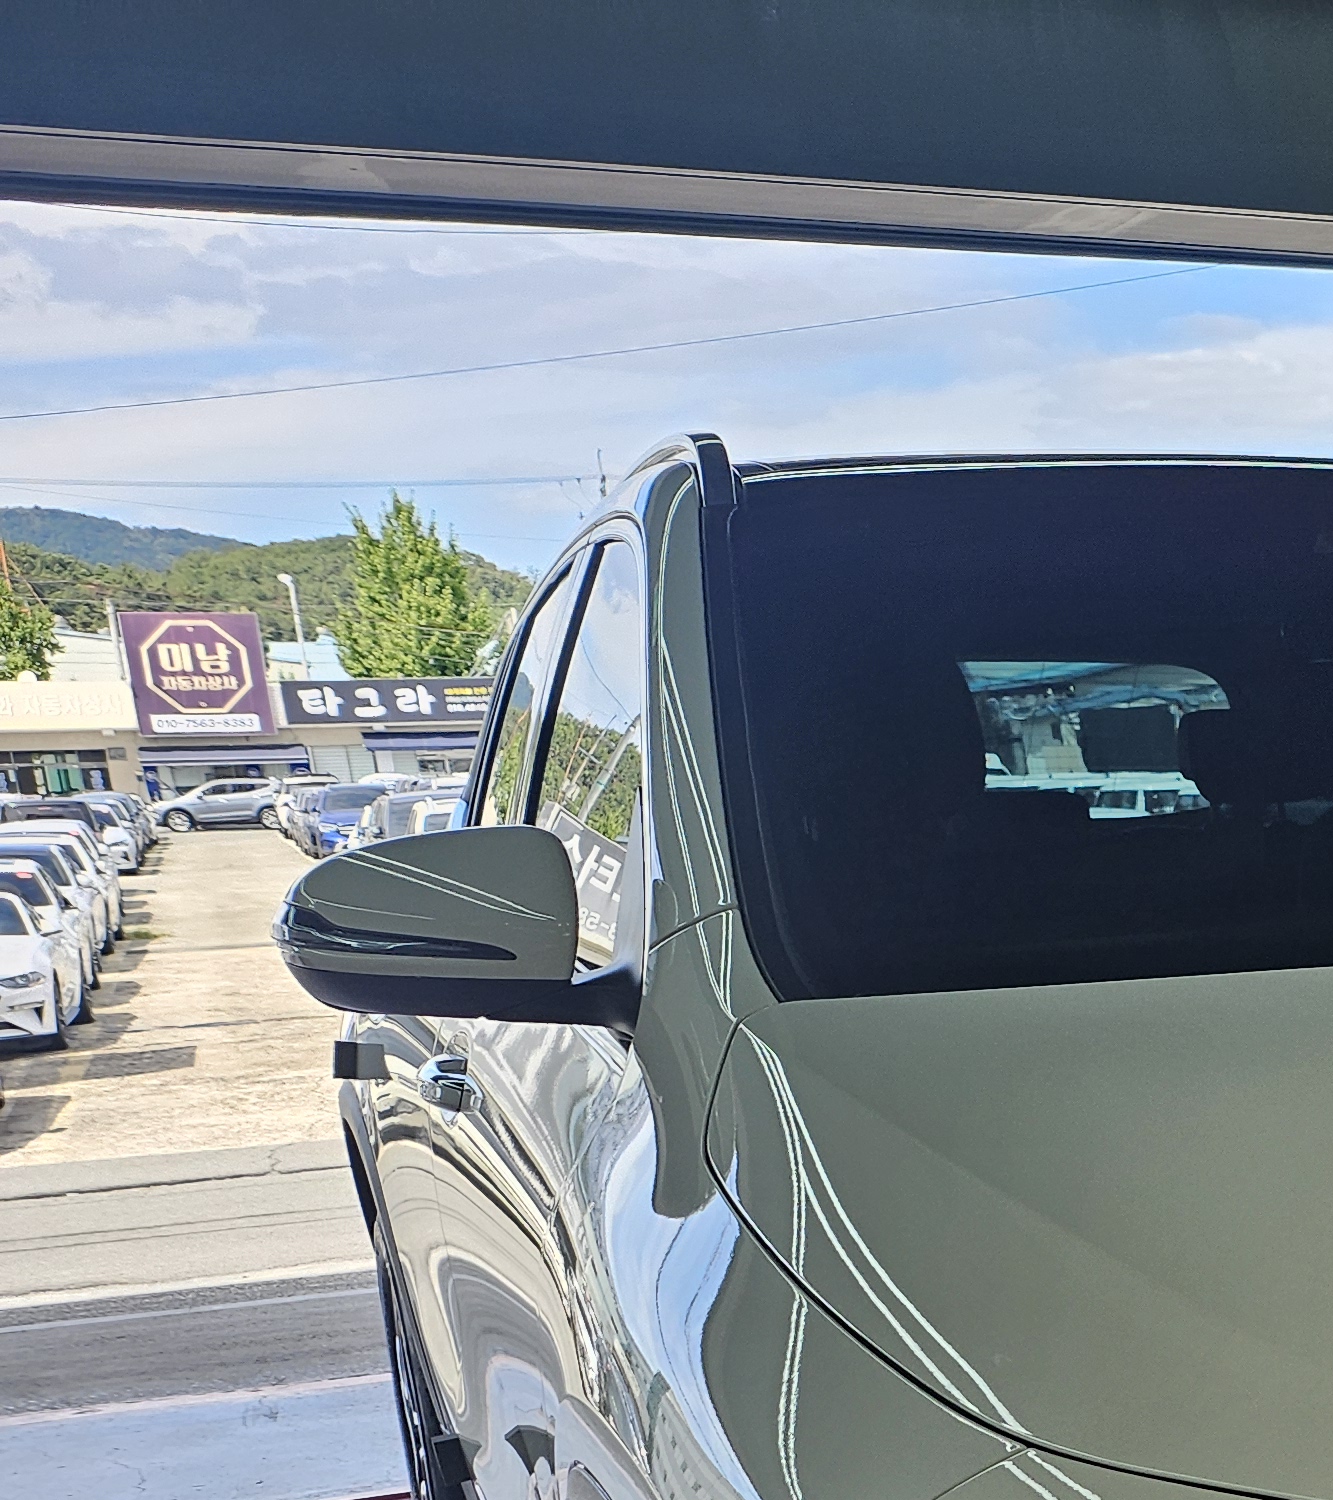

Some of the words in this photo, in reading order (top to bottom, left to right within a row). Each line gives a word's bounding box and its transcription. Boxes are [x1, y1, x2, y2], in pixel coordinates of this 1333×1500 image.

[157, 642, 232, 674] 미남
[159, 675, 238, 691] 자동차상사
[296, 684, 437, 718] 타그라
